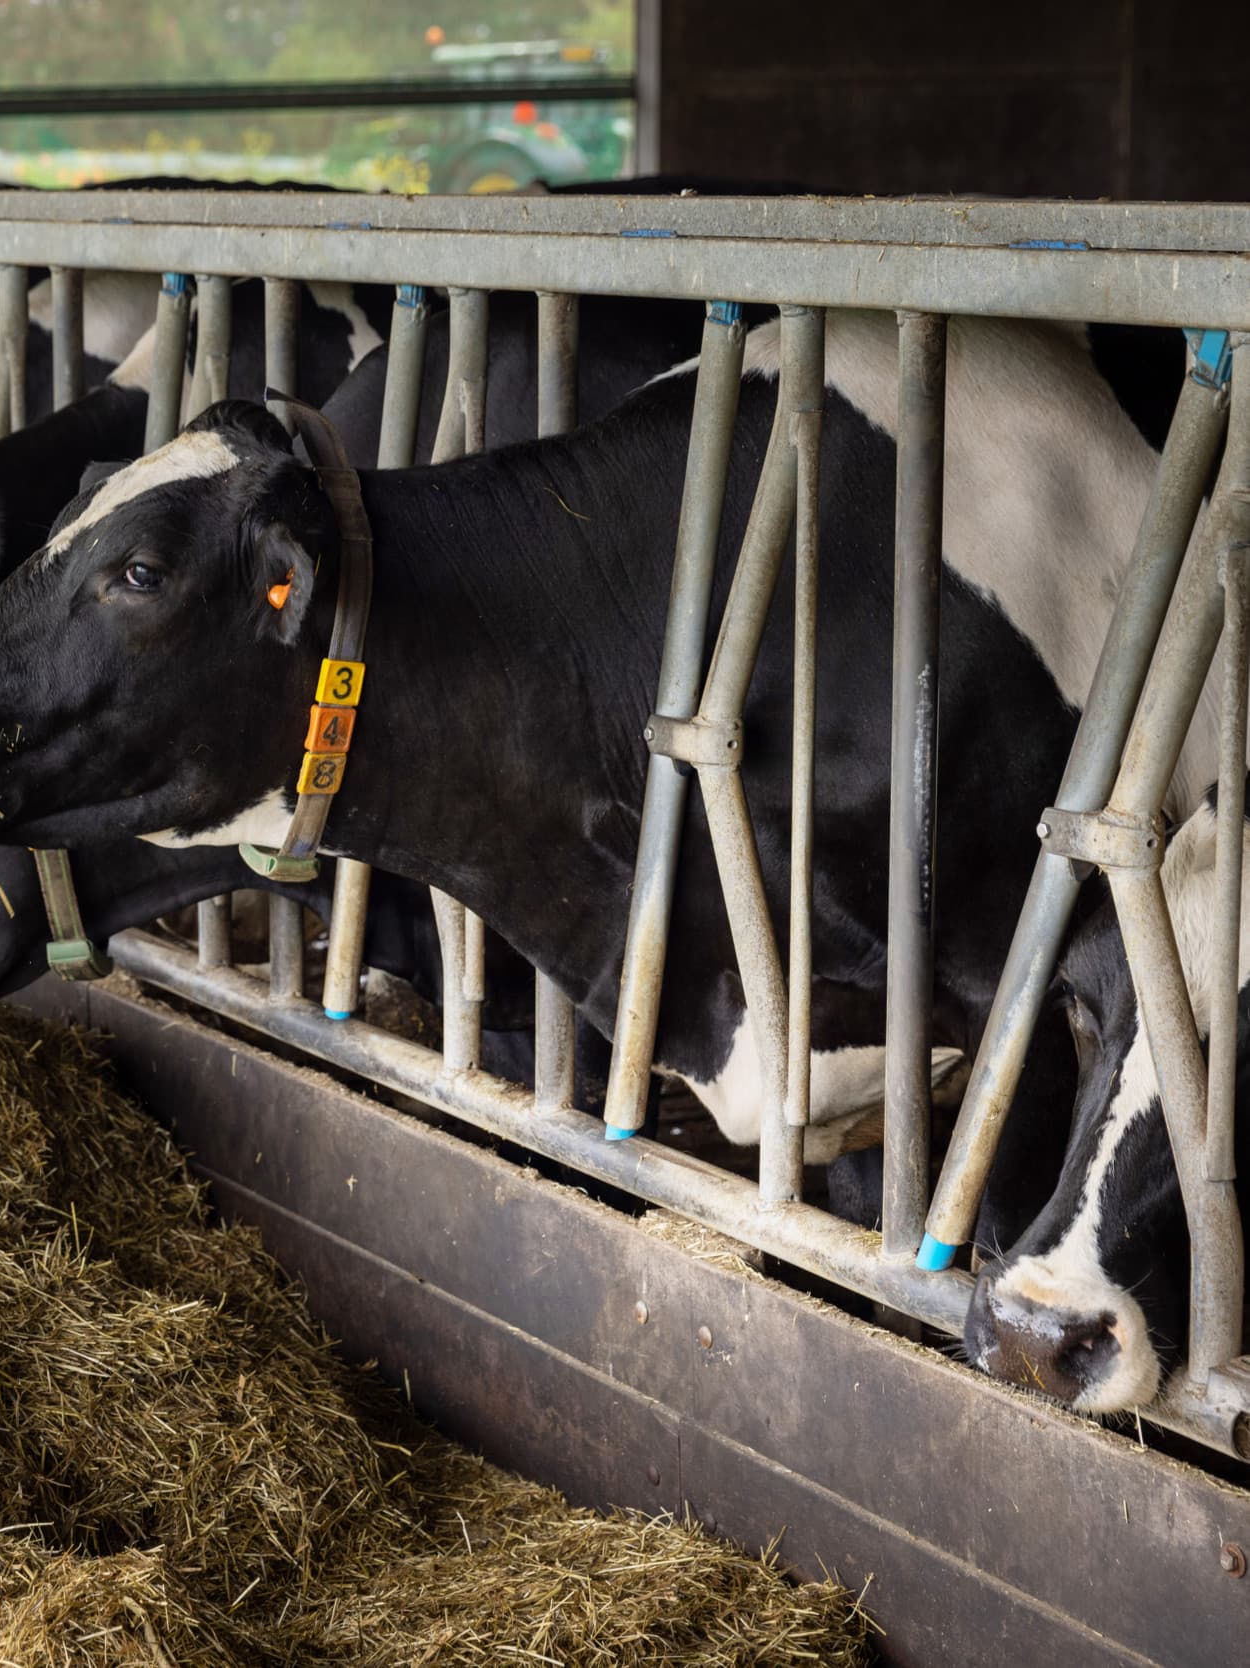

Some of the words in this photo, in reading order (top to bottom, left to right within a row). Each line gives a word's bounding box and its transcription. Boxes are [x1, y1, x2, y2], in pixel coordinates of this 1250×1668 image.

[332, 666, 353, 699] 3
[322, 715, 339, 746] 4
[312, 760, 336, 789] 8
